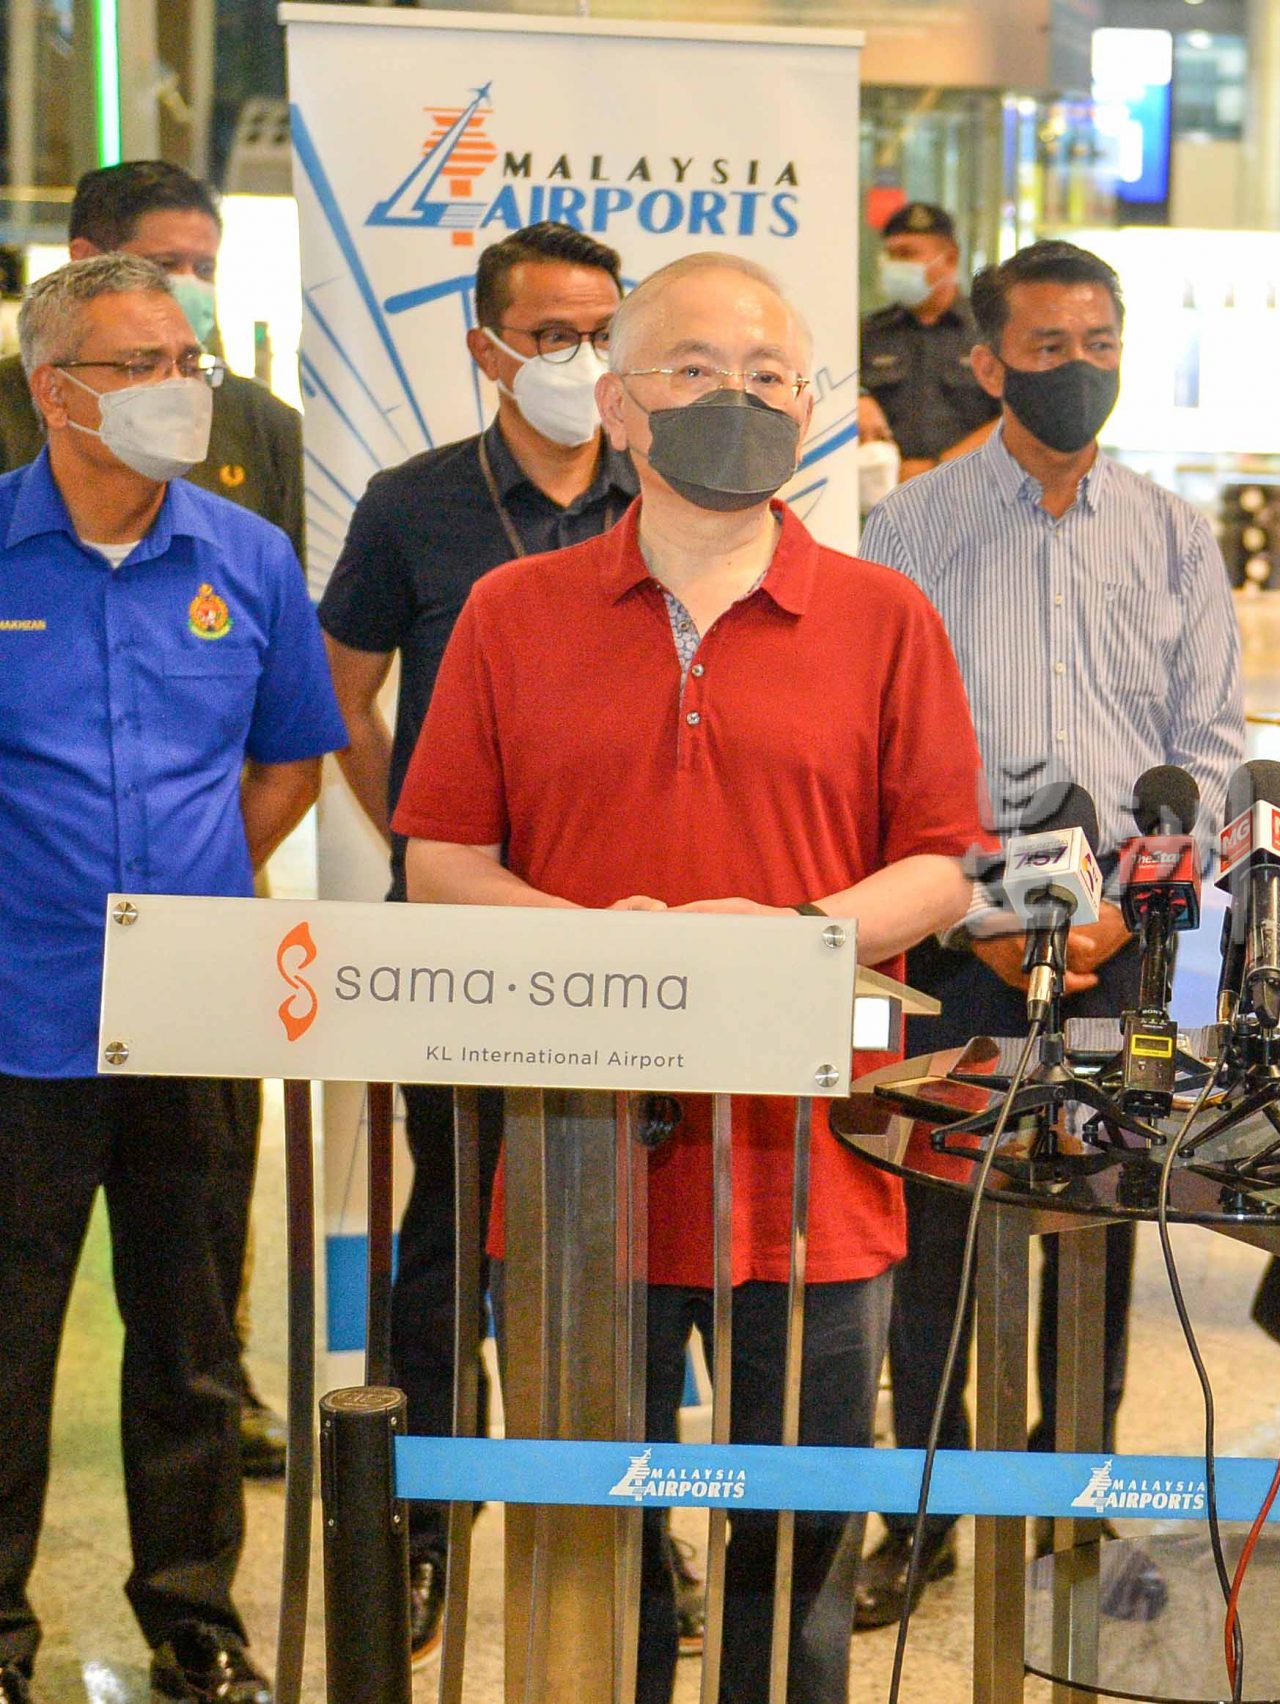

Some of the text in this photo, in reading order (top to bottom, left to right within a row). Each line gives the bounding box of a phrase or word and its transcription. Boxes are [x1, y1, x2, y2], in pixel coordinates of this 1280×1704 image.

[503, 151, 799, 186] MALAYSIA
[480, 185, 799, 238] AIRPORTS
[335, 965, 688, 1010] sama sama
[426, 1045, 685, 1070] KL International Airport
[651, 1468, 746, 1480] MALAYSIA
[644, 1480, 745, 1498] AIRPORTS
[1112, 1479, 1206, 1492] MALAYSIA
[1105, 1491, 1205, 1510] AIRPORTS
